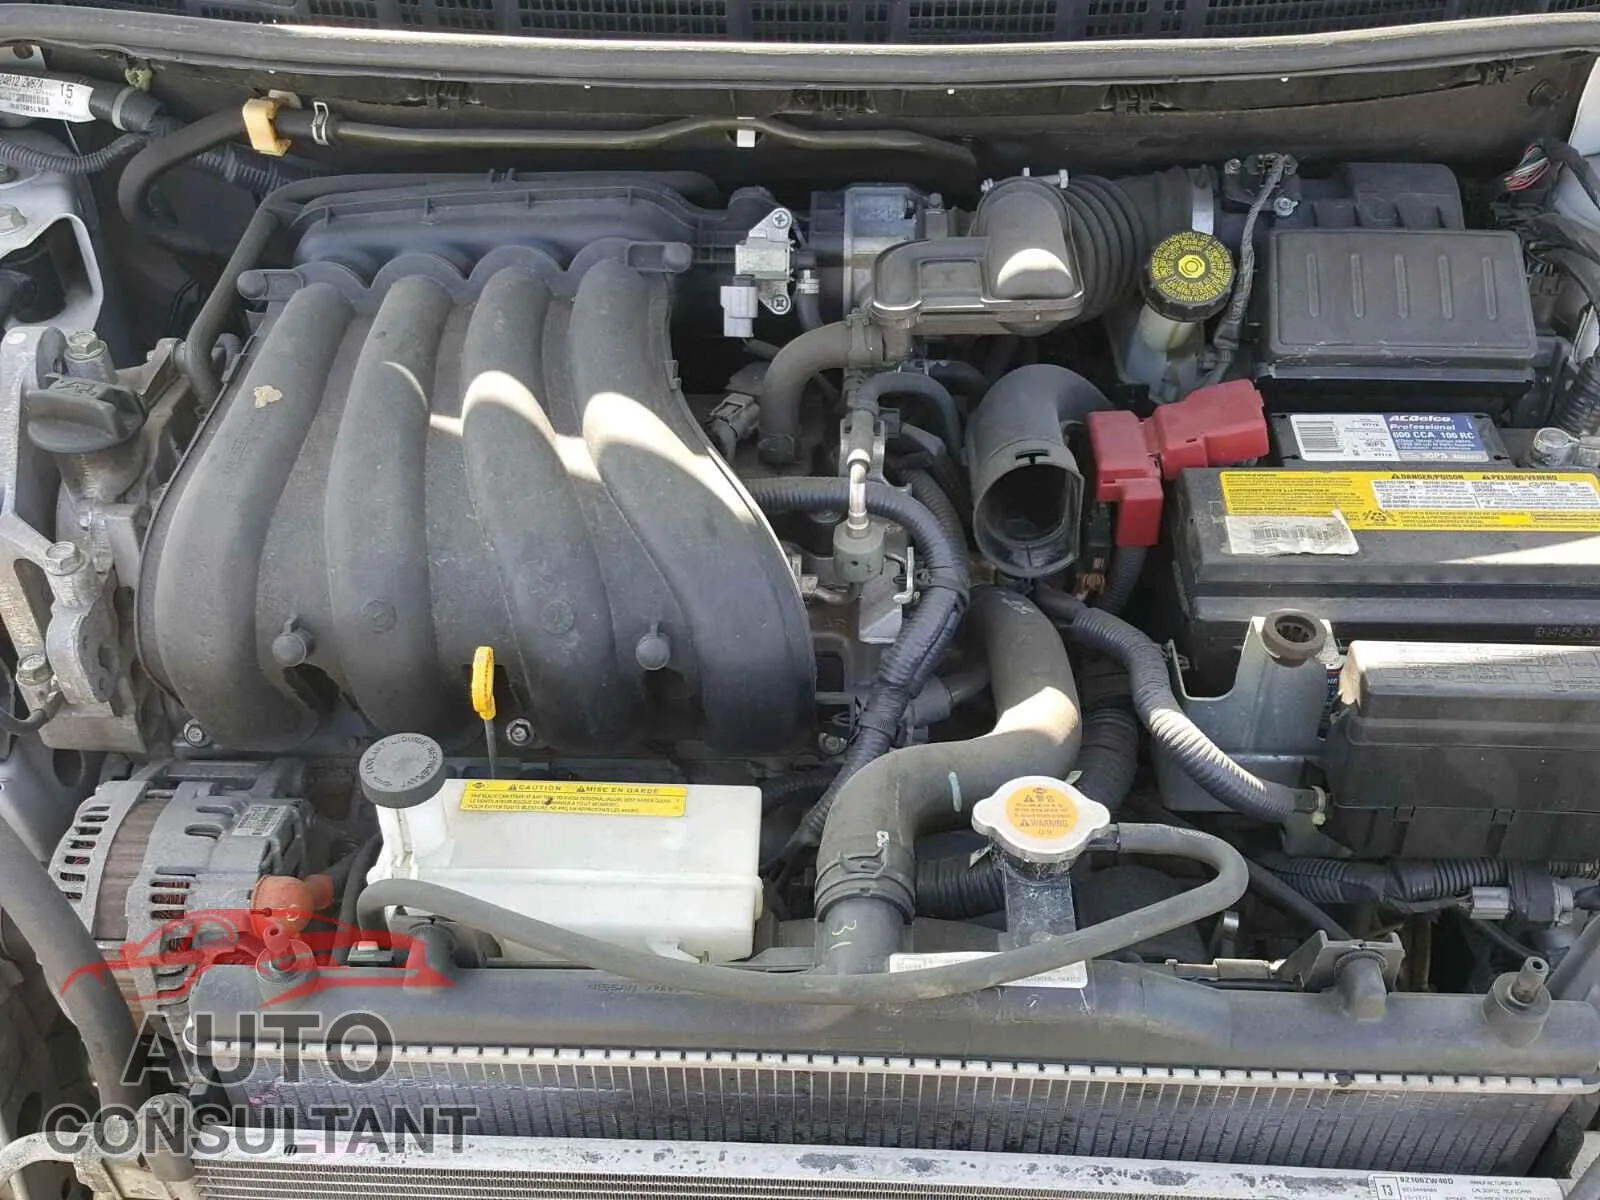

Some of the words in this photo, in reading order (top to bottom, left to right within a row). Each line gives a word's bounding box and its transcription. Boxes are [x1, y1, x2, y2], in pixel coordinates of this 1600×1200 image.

[60, 82, 74, 99] 15
[1390, 423, 1456, 431] Professional
[1440, 432, 1458, 440] 100
[1461, 432, 1475, 440] RC
[518, 784, 561, 792] CAUTION
